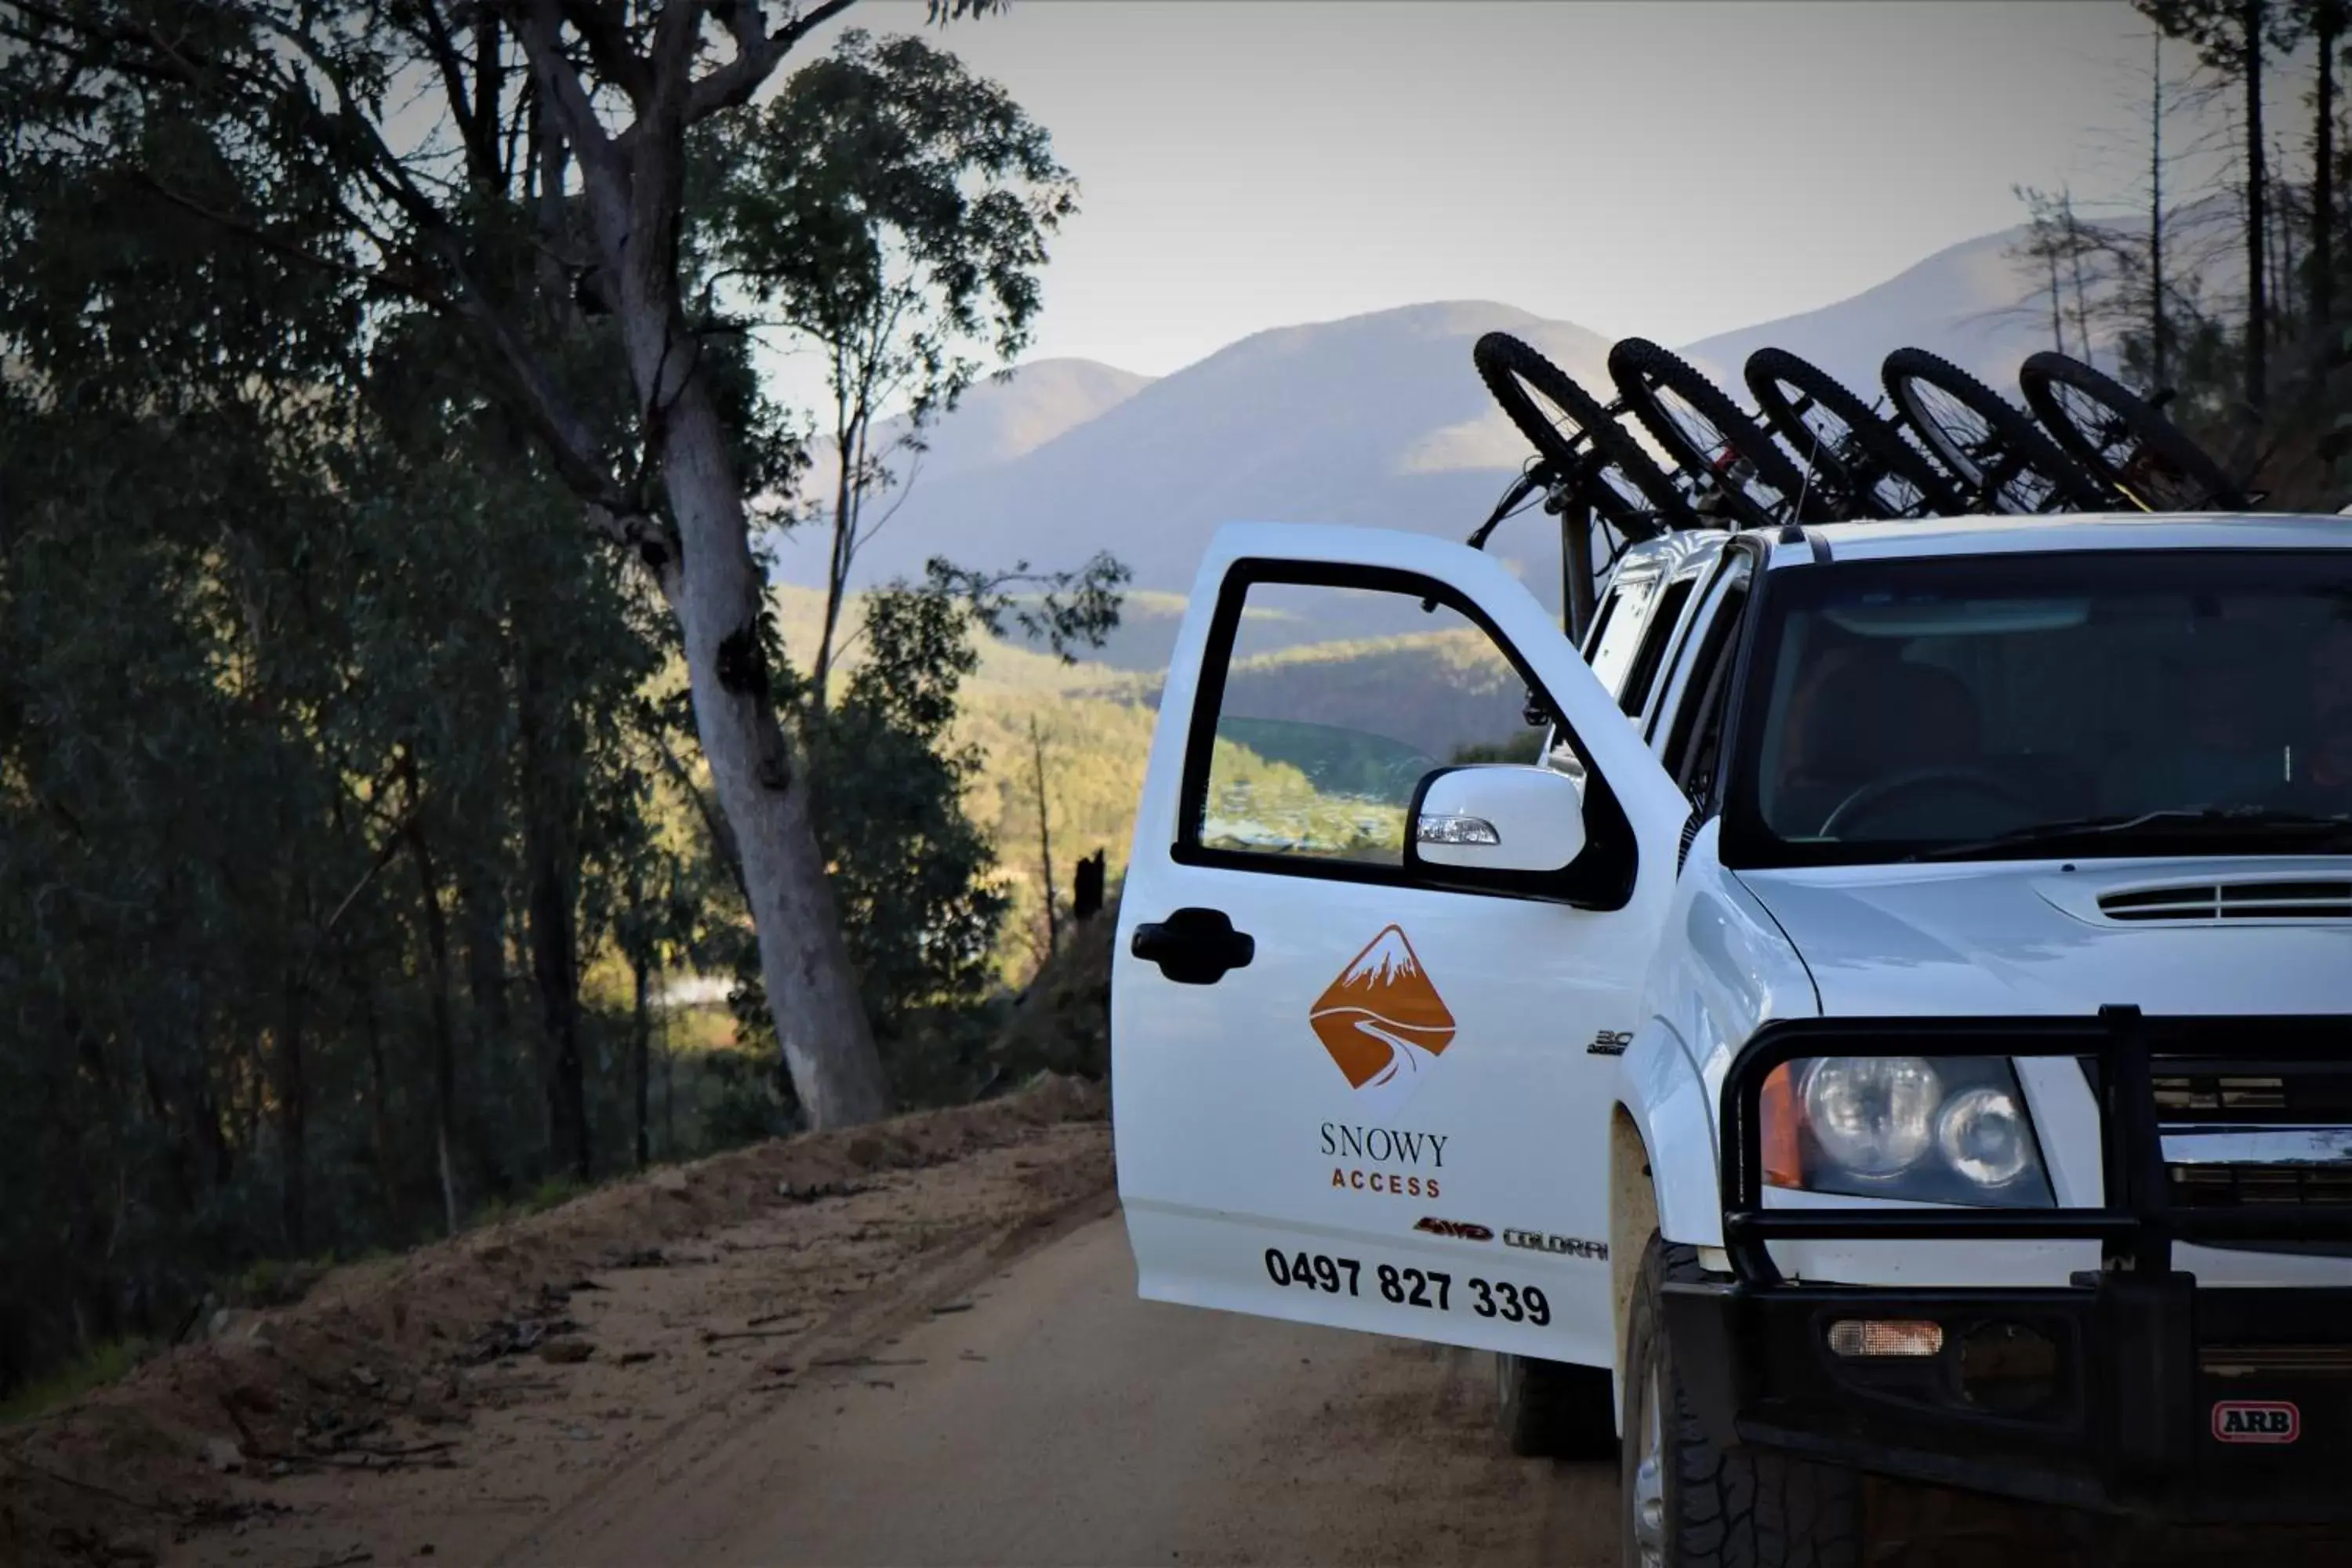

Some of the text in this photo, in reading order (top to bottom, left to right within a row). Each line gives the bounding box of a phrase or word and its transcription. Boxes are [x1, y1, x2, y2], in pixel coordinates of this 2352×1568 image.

[1321, 1122, 1448, 1167] SNOWY
[1332, 1168, 1440, 1198] ACCESS
[1503, 1228, 1609, 1261] COLORA
[1265, 1248, 1551, 1327] 0497 827 339
[2223, 1410, 2290, 1433] ARB
